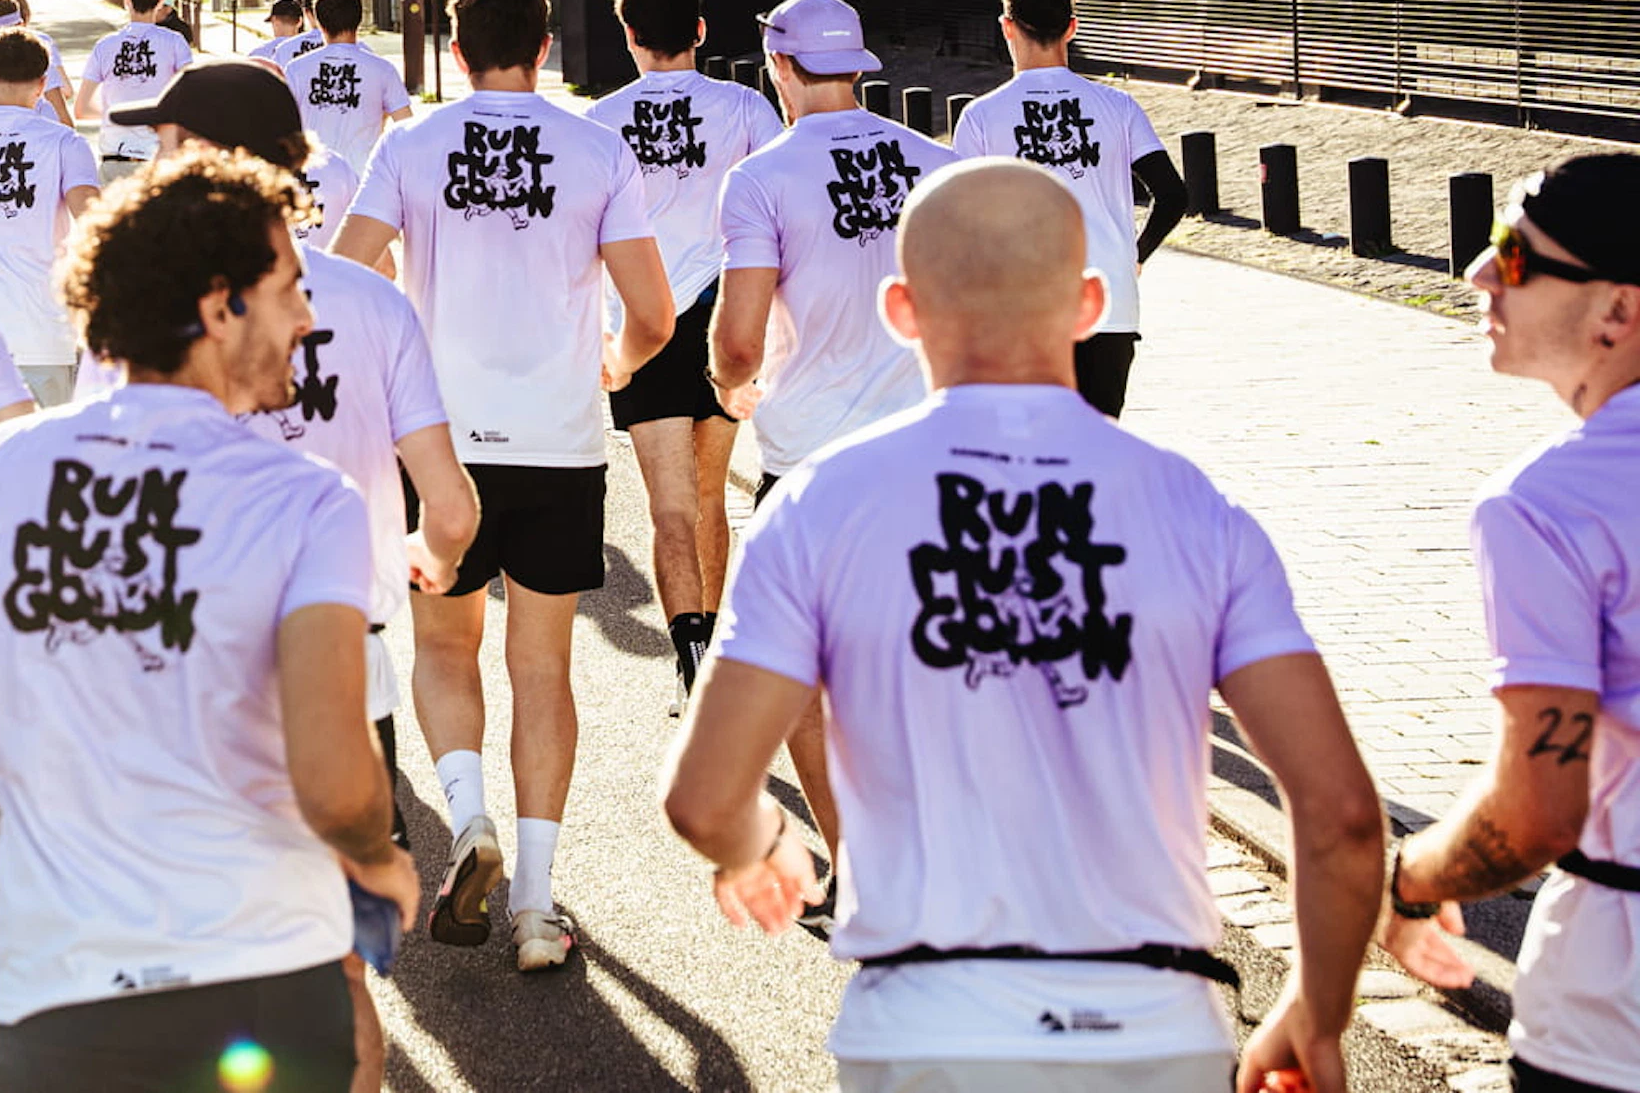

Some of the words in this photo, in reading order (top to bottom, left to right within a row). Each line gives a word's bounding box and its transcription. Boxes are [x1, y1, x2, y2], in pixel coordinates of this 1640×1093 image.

[115, 52, 155, 66] MUST
[122, 40, 149, 55] RUN
[311, 78, 362, 95] MUST
[320, 63, 356, 81] RUN
[634, 96, 692, 126] RUN
[1022, 98, 1081, 126] RUN
[465, 121, 540, 155] RUN
[1014, 119, 1094, 147] MUST
[448, 151, 553, 185] MUST
[830, 140, 905, 183] RUN
[48, 459, 188, 528] RUN
[935, 471, 1095, 549] RUN
[13, 520, 202, 592] MUST
[908, 541, 1127, 613] MUST
[1528, 707, 1593, 765] 22
